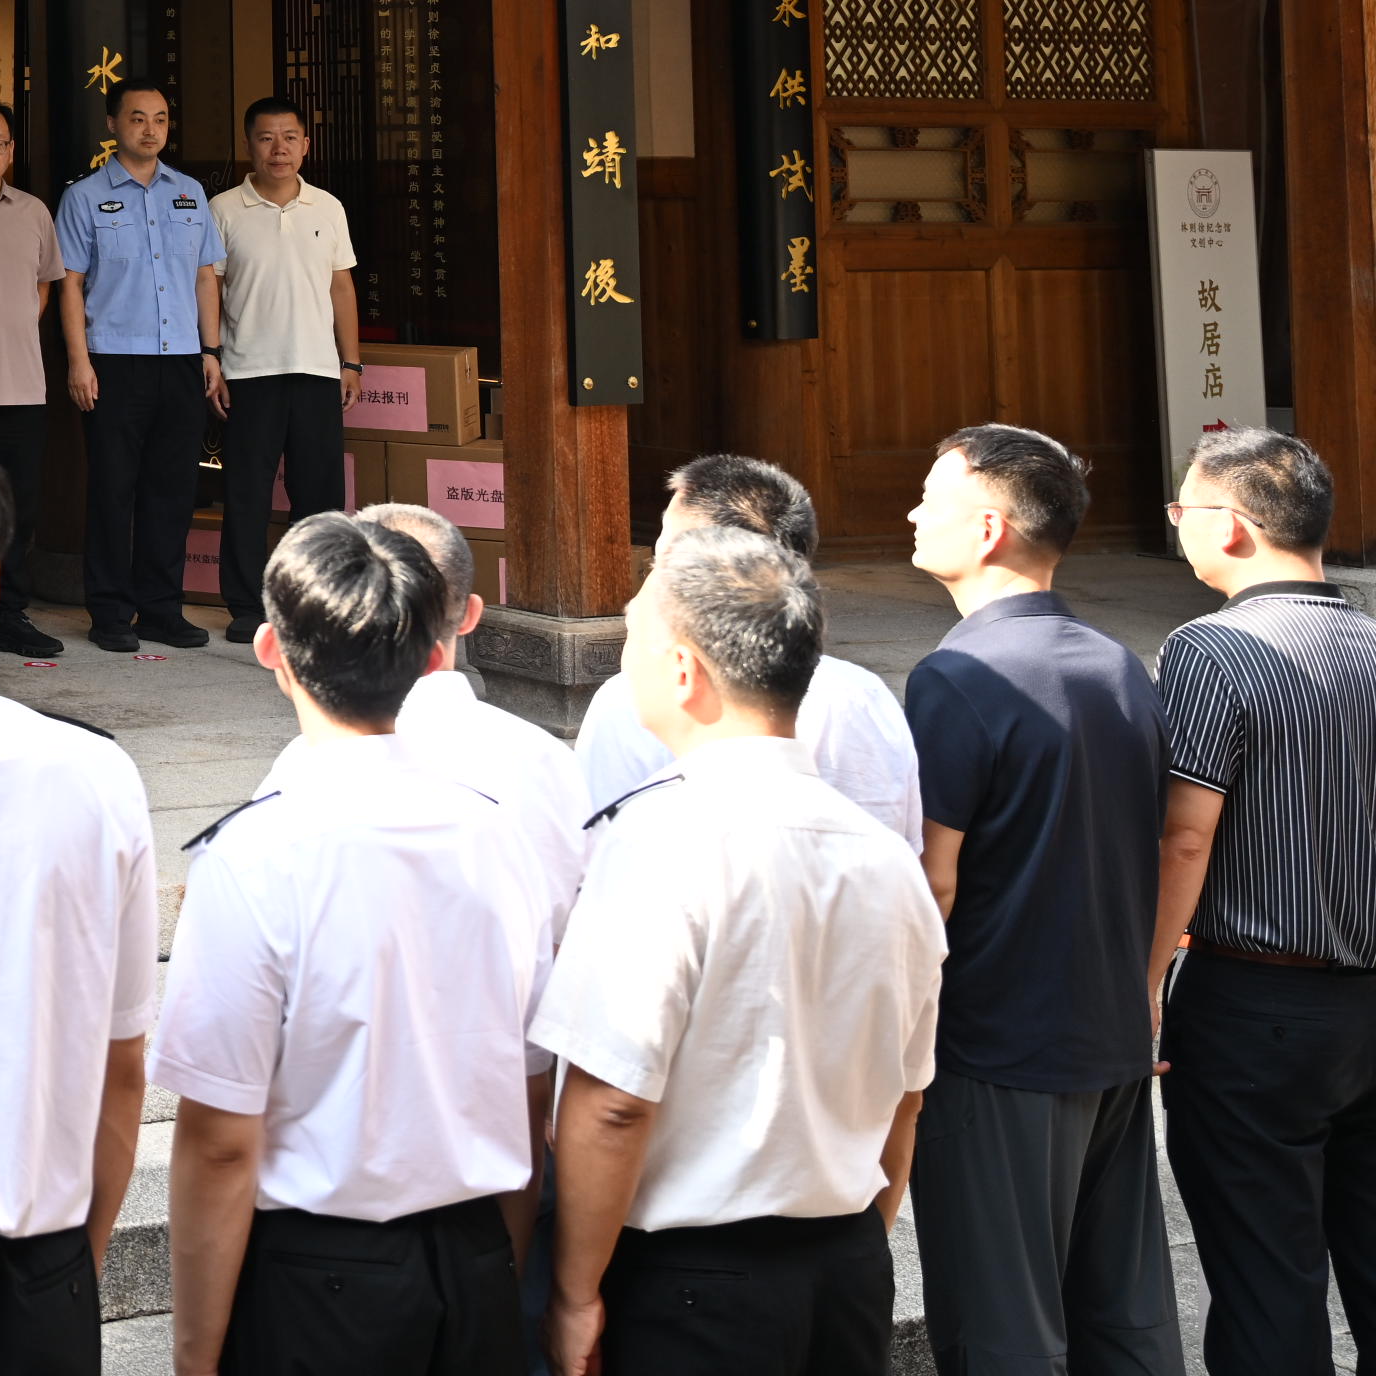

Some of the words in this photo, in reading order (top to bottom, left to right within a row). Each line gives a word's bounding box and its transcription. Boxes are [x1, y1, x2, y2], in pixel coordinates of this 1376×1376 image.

[1197, 279, 1224, 400] 故居店
[445, 486, 505, 504] 盗版光盘
